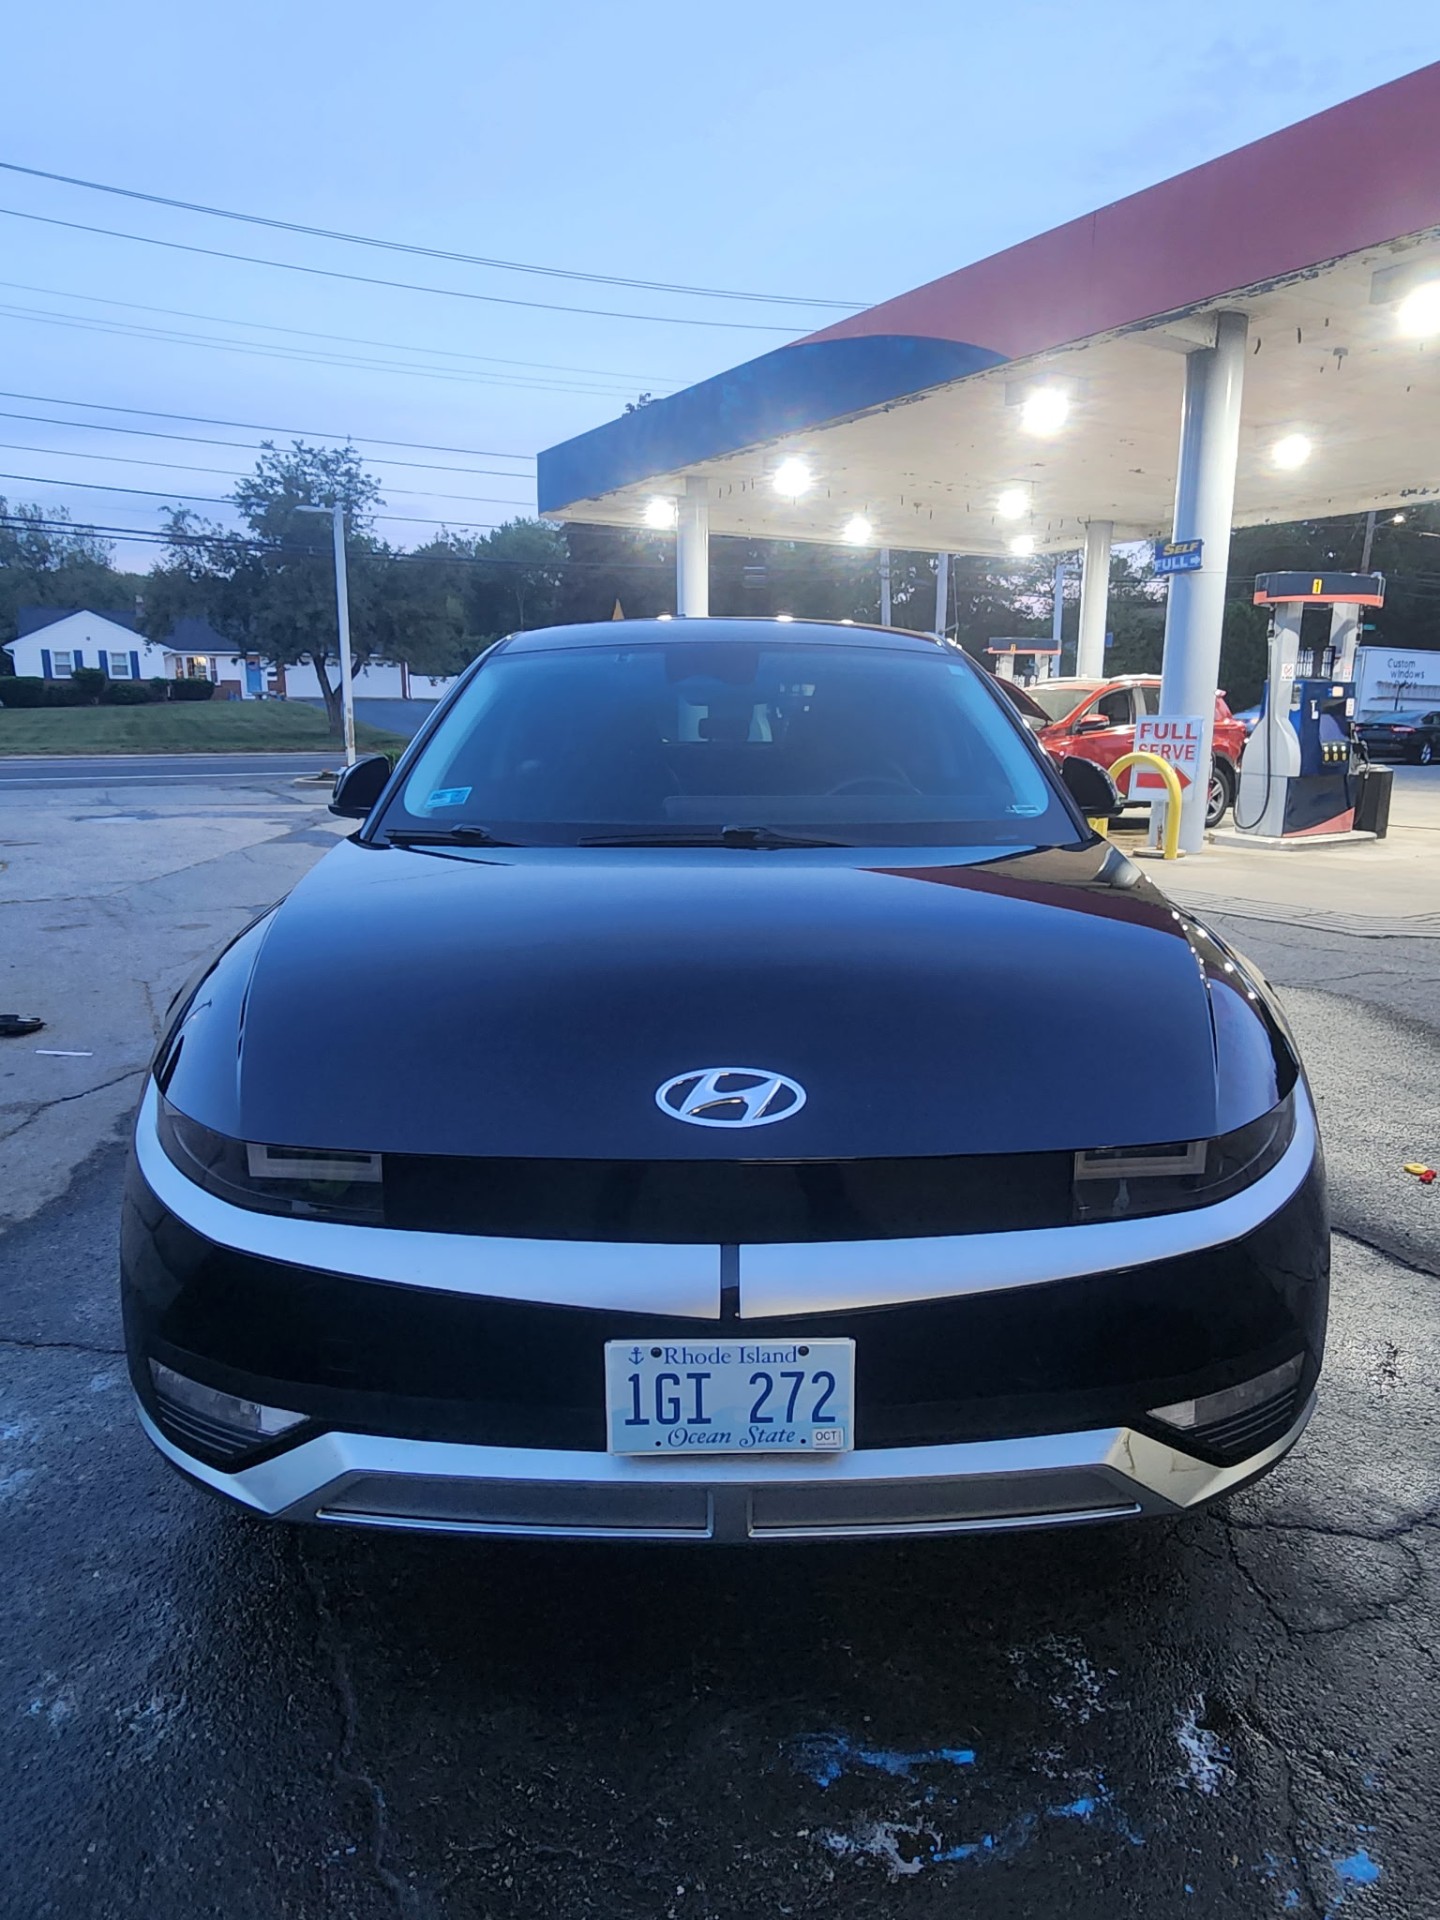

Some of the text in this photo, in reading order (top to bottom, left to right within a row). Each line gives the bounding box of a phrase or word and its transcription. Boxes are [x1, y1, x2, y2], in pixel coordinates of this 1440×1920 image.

[1155, 556, 1188, 571] FULL
[1387, 658, 1416, 668] Custom
[1140, 723, 1197, 739] FULL
[663, 1345, 798, 1365] Rhode Island
[625, 1371, 836, 1426] 1GI 272
[668, 1425, 796, 1447] Ocean State
[815, 1431, 837, 1441] OCT
